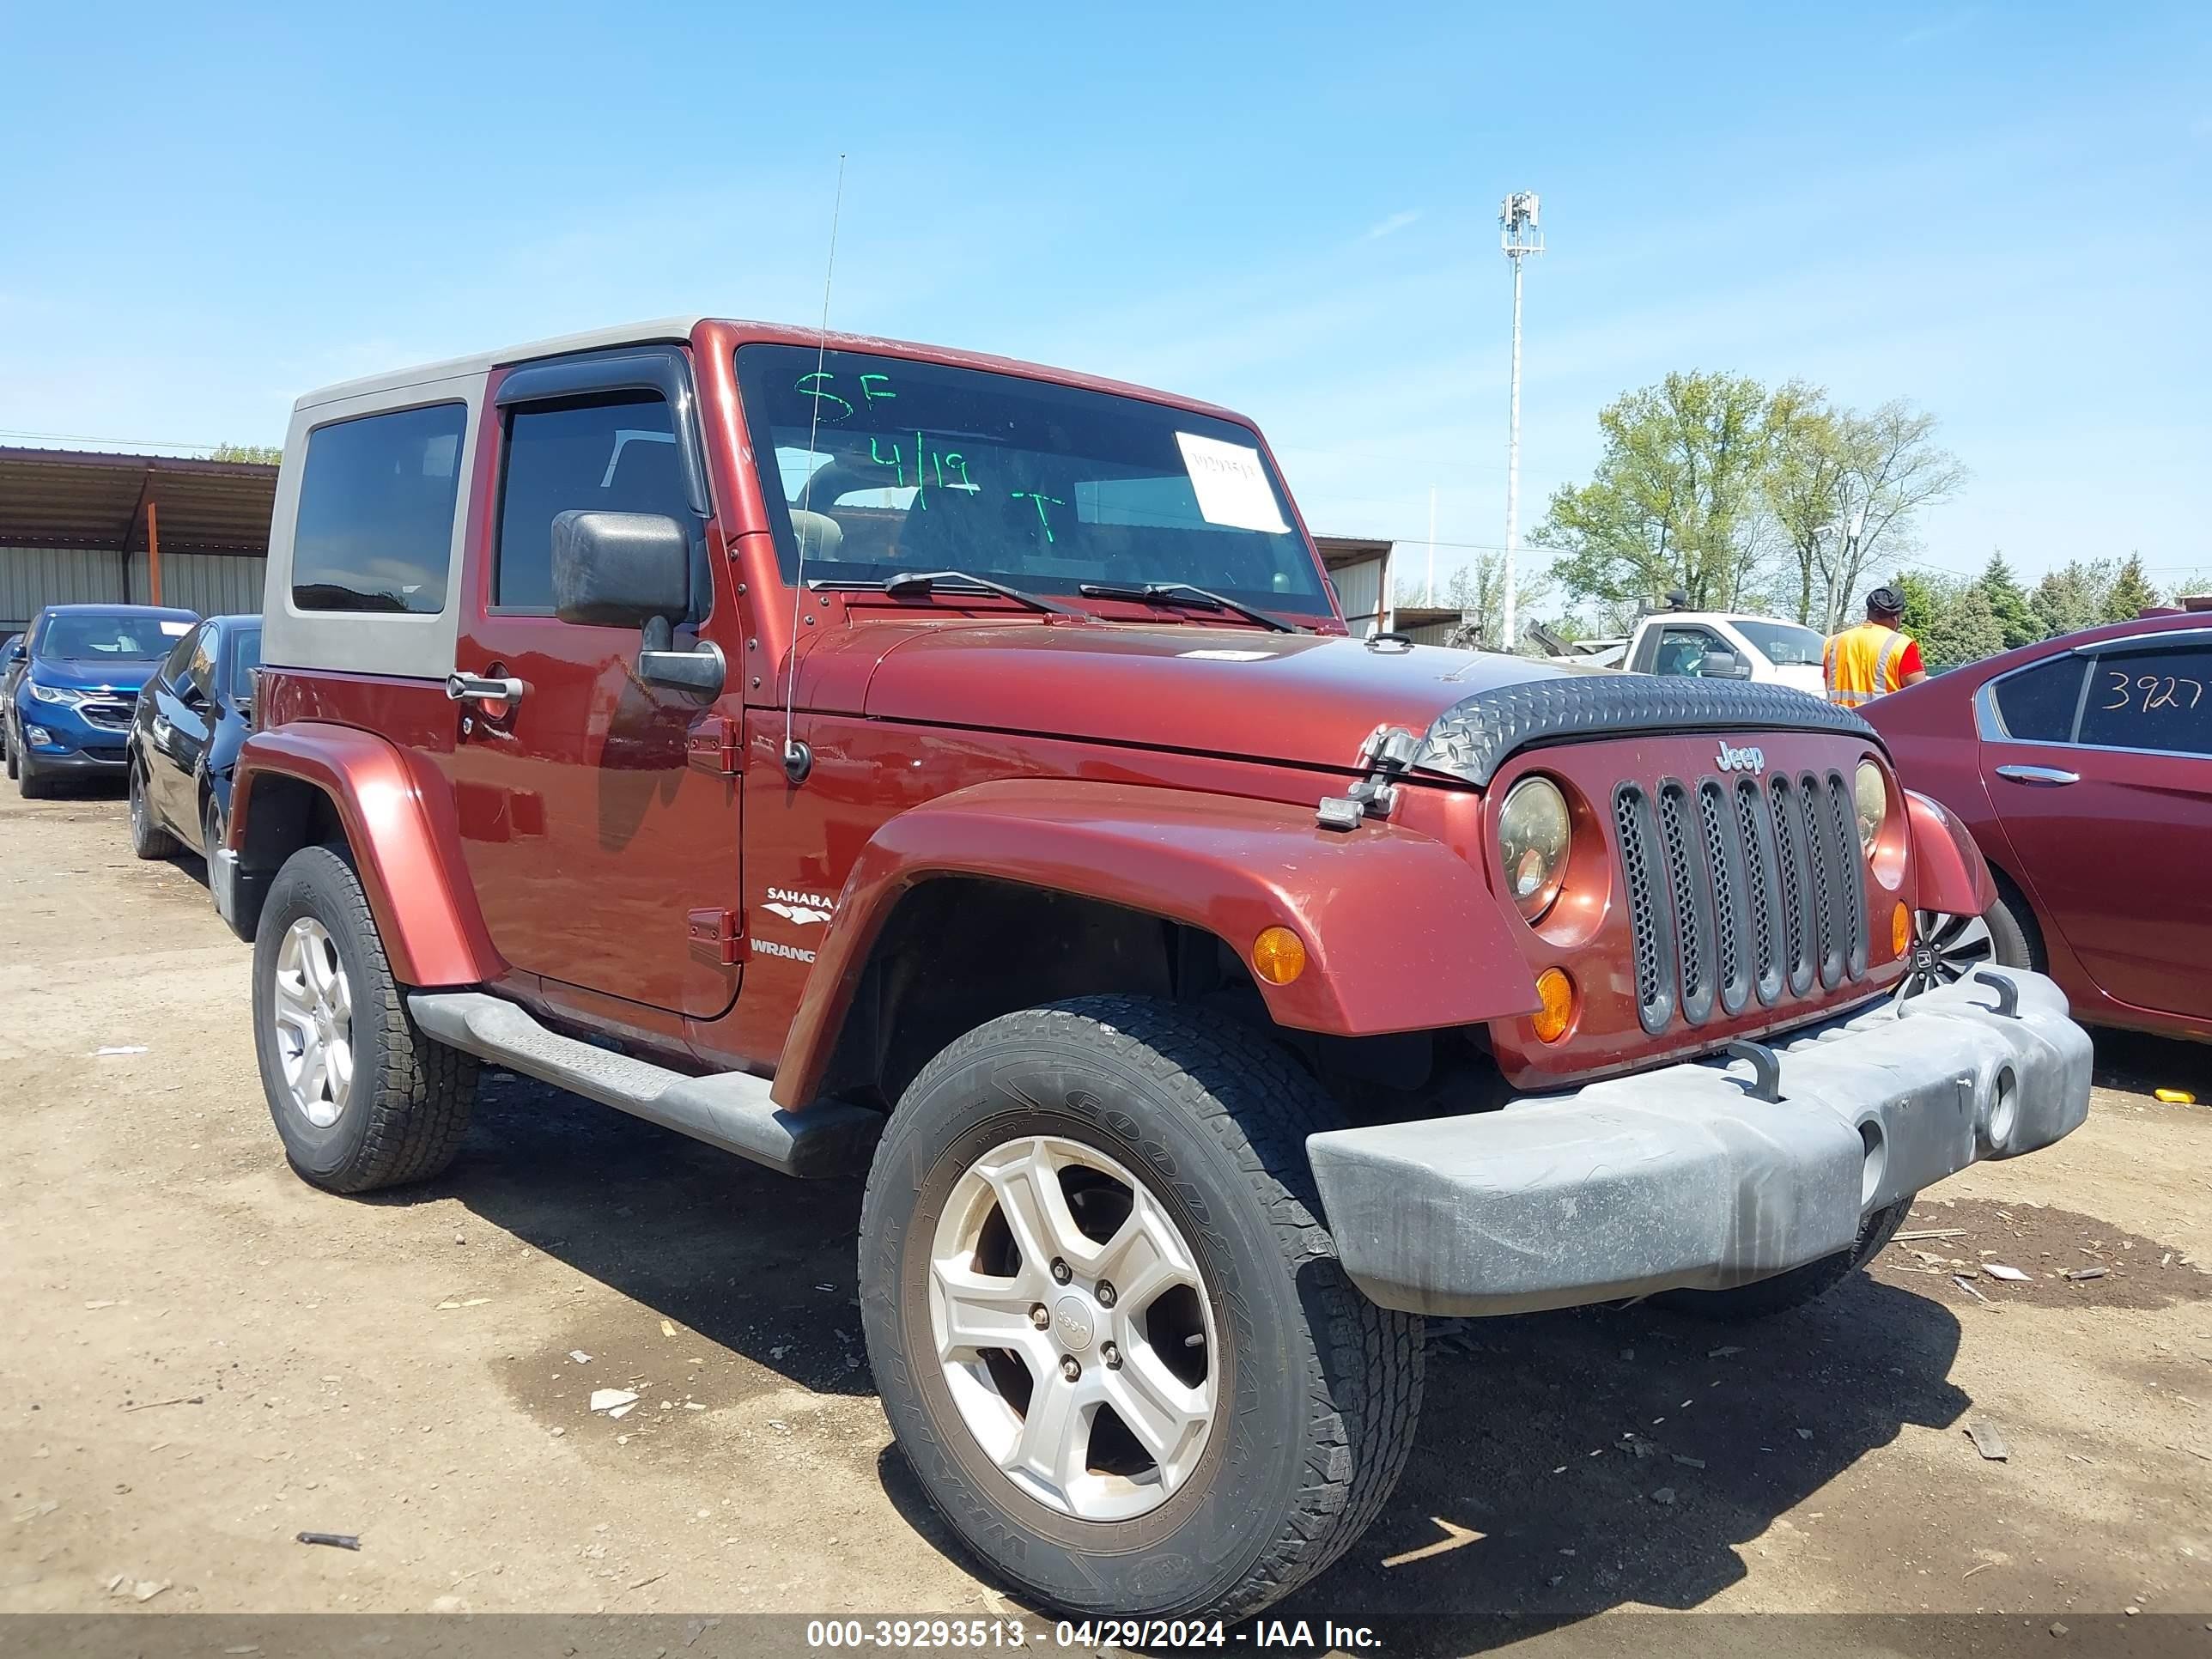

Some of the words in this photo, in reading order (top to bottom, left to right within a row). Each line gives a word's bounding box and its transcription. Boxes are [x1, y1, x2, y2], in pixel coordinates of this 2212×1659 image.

[870, 431, 975, 511] 4/19
[1012, 492, 1065, 543] T
[2102, 672, 2212, 713] 3927
[1715, 740, 1765, 775] Jeep
[767, 887, 834, 909] SAHARA
